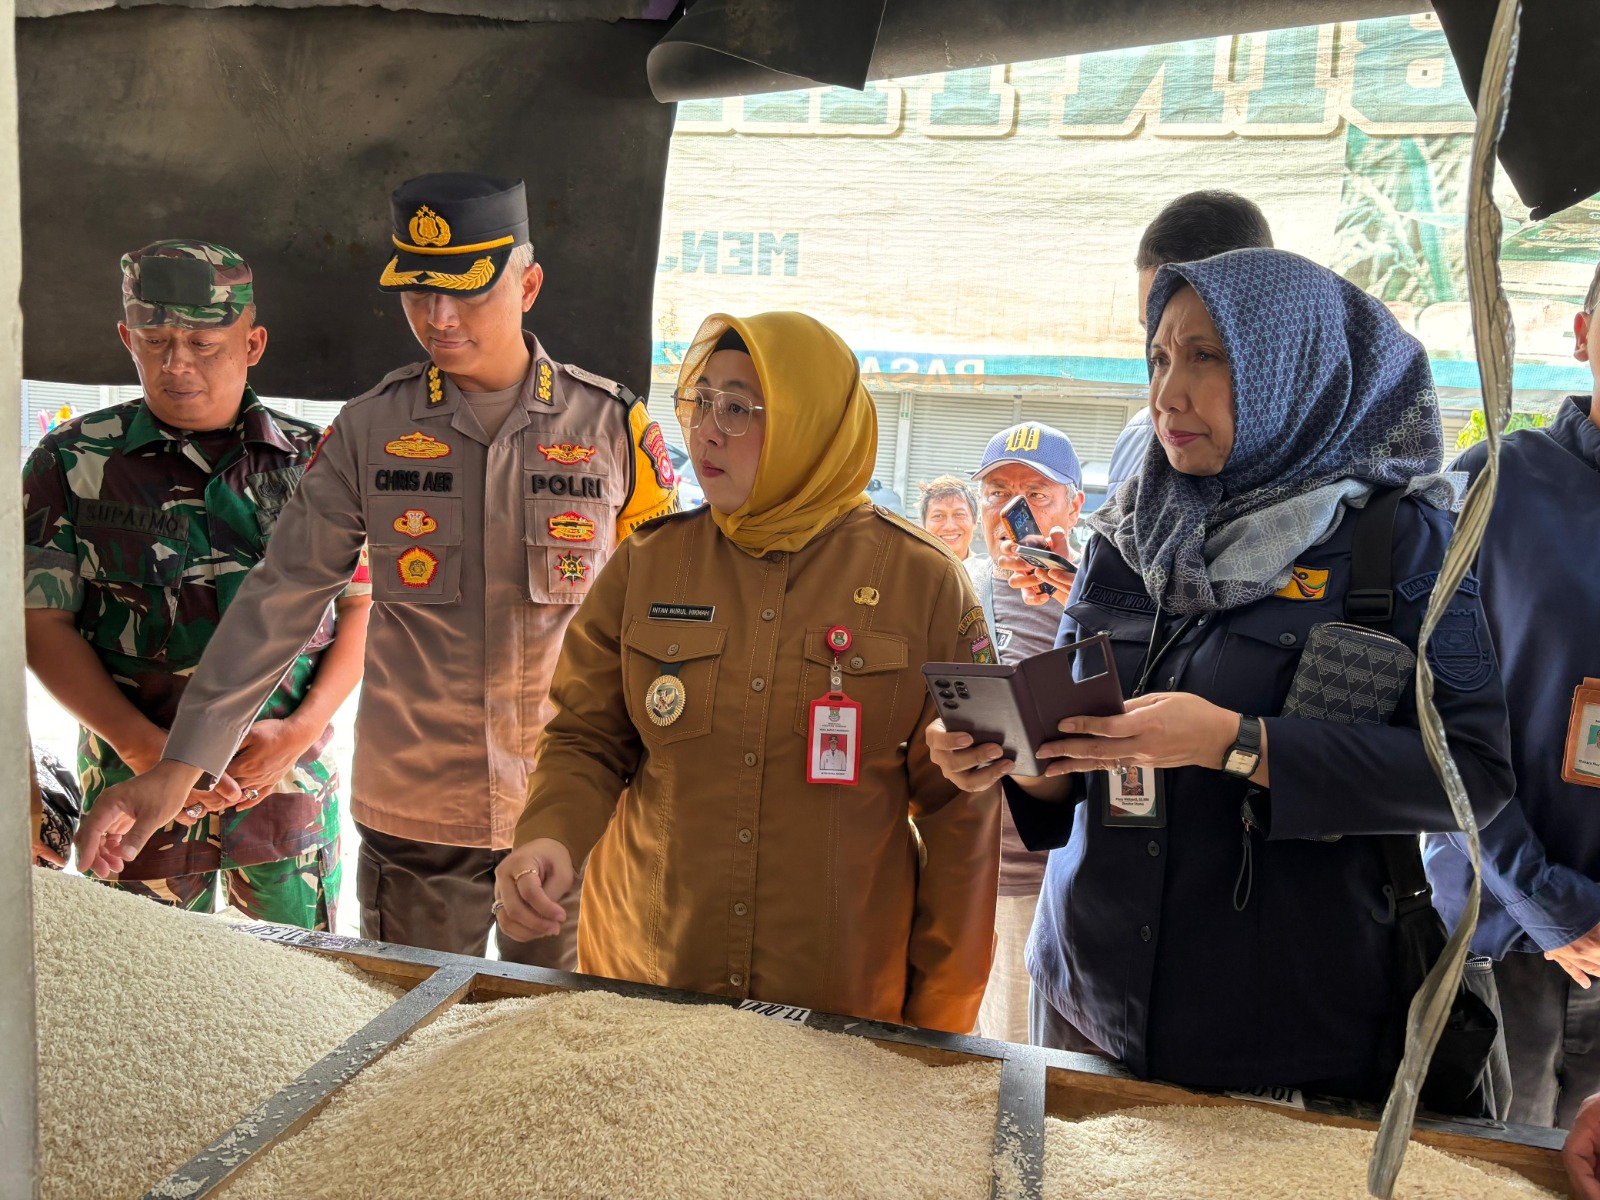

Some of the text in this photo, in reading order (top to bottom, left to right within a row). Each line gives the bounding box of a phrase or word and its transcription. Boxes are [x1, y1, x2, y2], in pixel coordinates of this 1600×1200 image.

[375, 469, 454, 493] CHRIS AER
[532, 474, 603, 498] POLRI
[1090, 588, 1122, 605] FINNY
